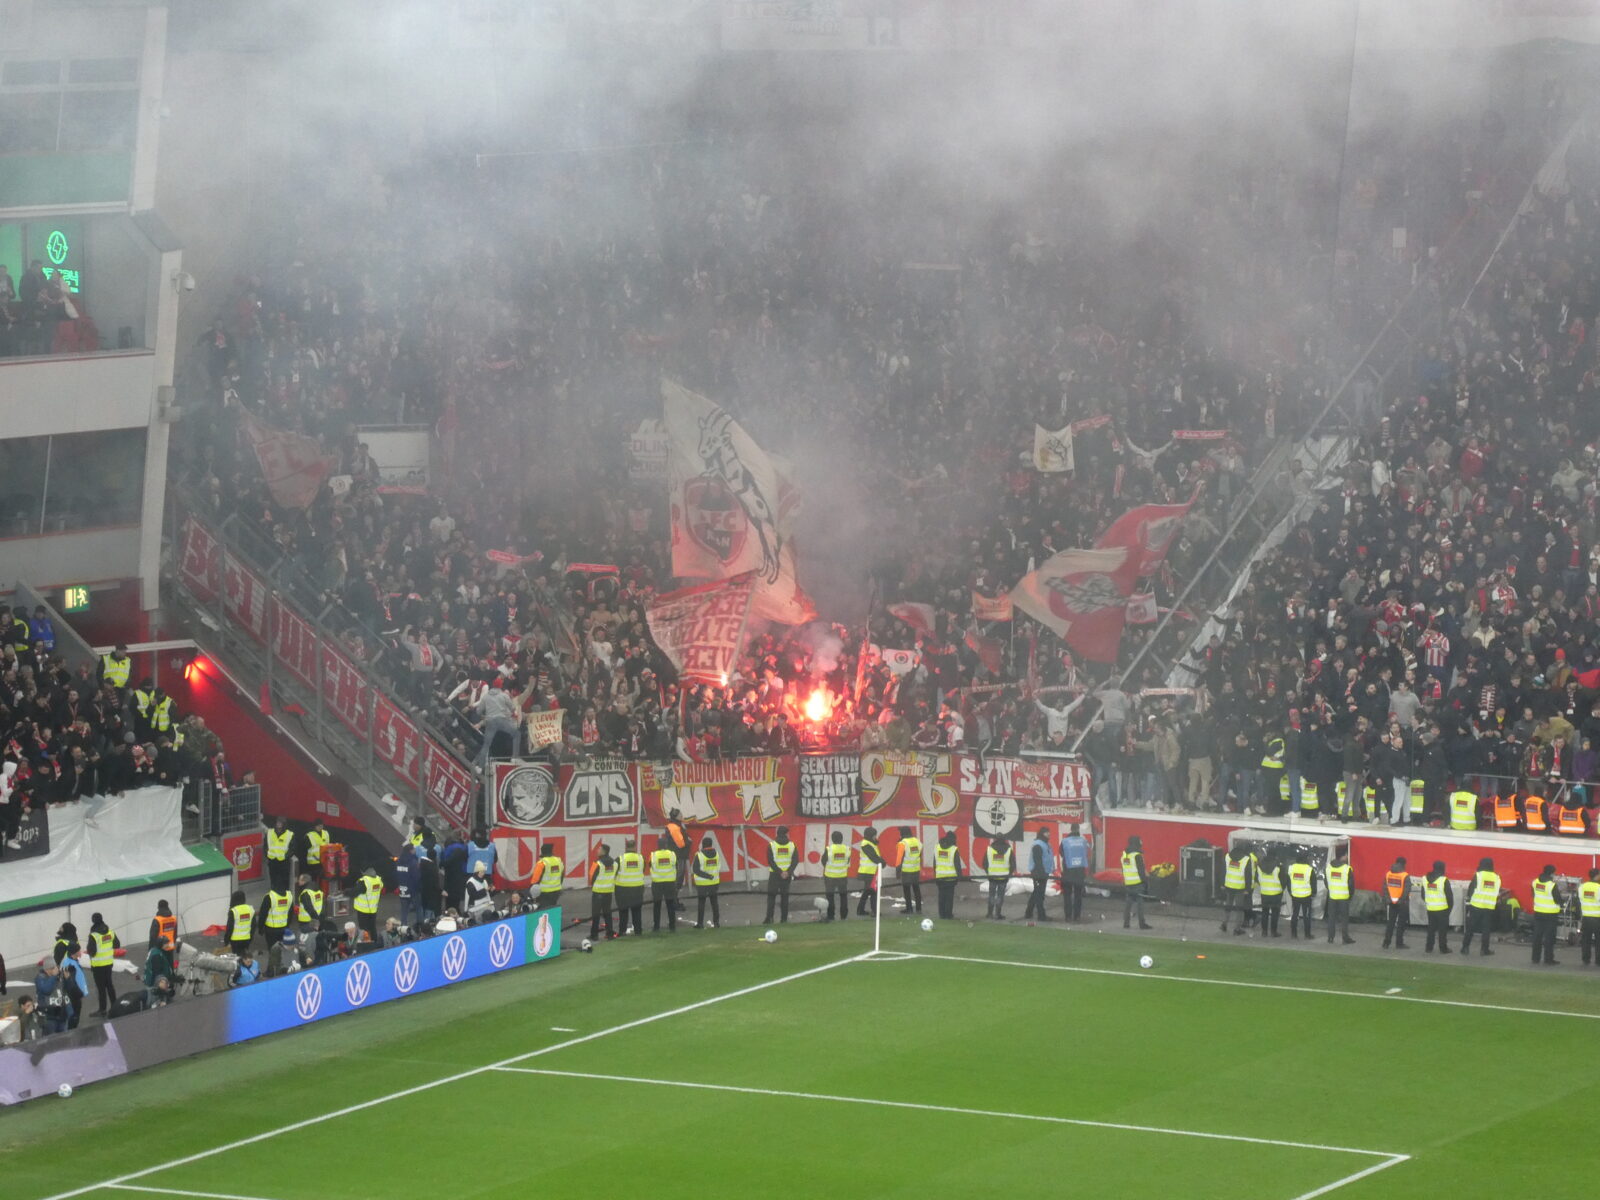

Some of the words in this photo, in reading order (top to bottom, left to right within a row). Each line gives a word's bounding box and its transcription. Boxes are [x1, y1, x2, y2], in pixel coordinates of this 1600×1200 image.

[800, 756, 860, 774] SEKTION
[569, 772, 631, 818] CNS
[801, 772, 859, 798] STADT
[801, 795, 860, 816] VERBOT
